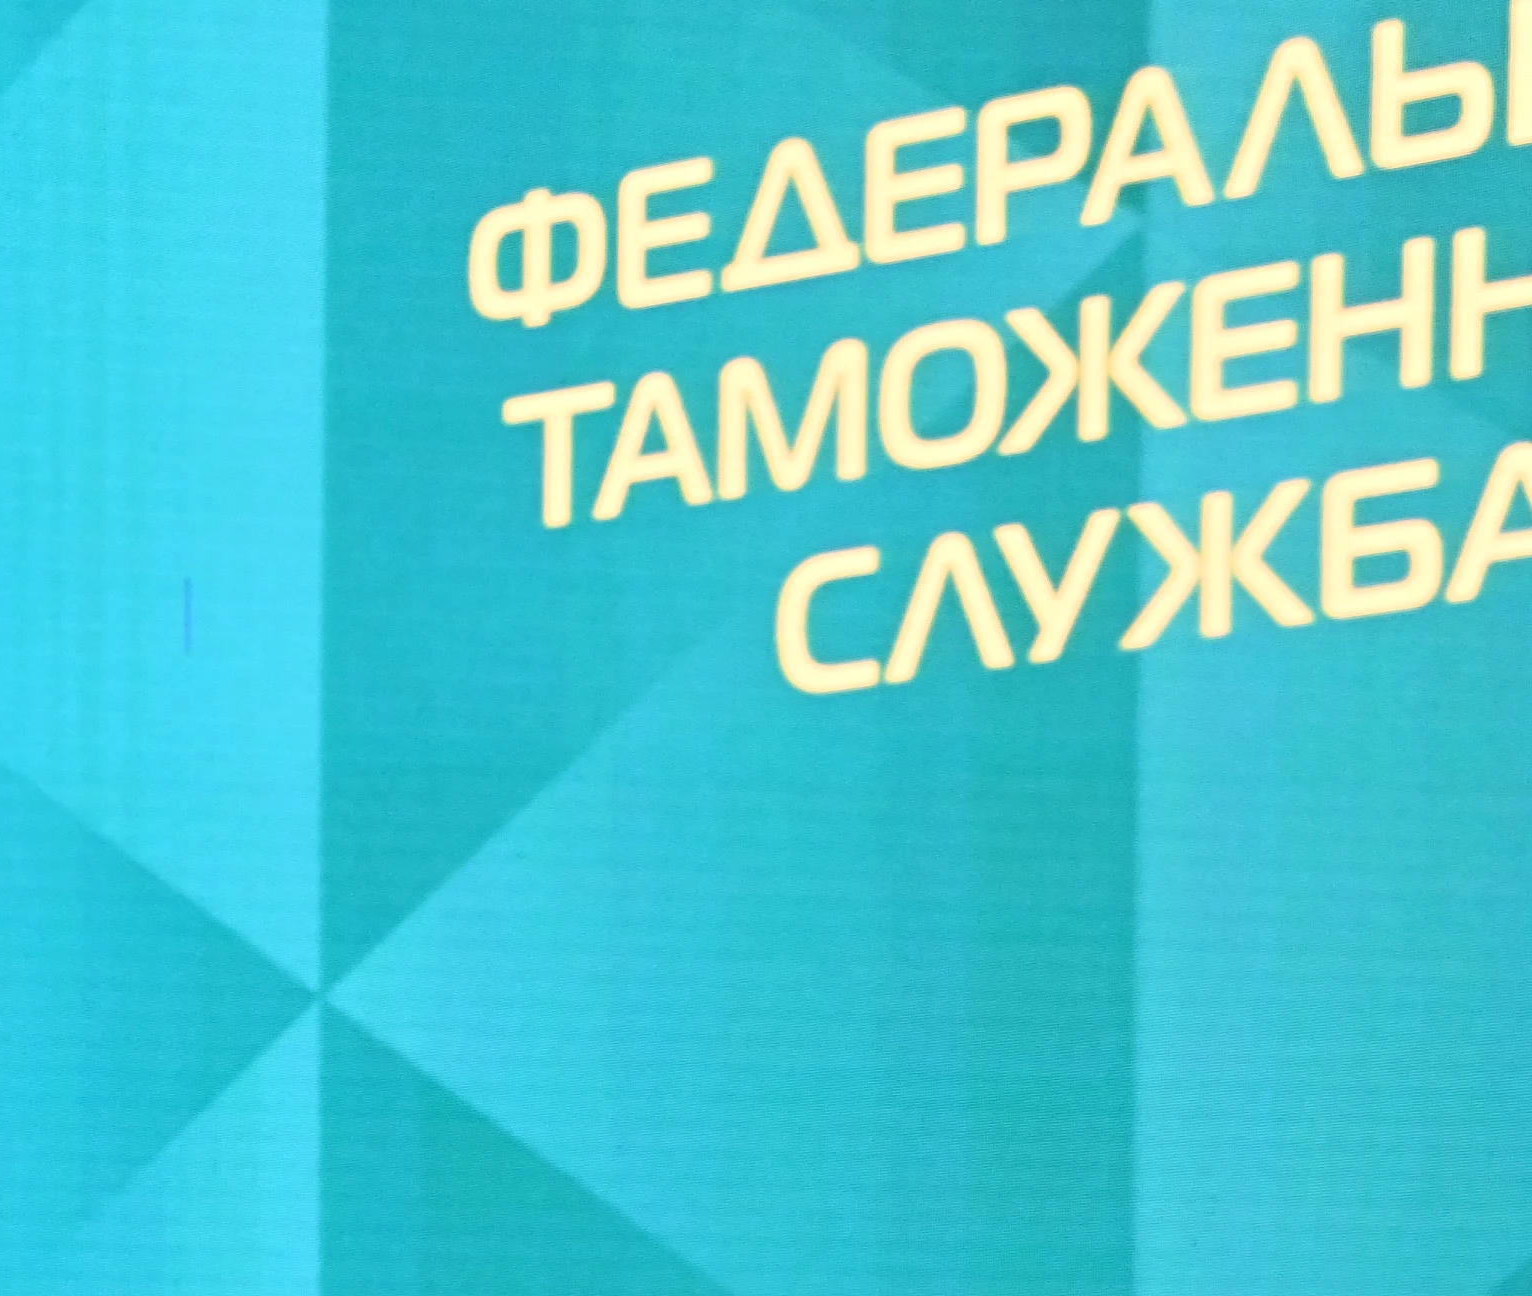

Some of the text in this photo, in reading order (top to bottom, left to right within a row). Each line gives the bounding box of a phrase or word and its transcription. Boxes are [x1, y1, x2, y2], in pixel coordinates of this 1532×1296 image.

[466, 0, 1532, 328] ФЕДЕРАЛЬ
[501, 225, 1532, 528] ТАМОЖЕНН
[775, 440, 1532, 694] СЛУЖБА
